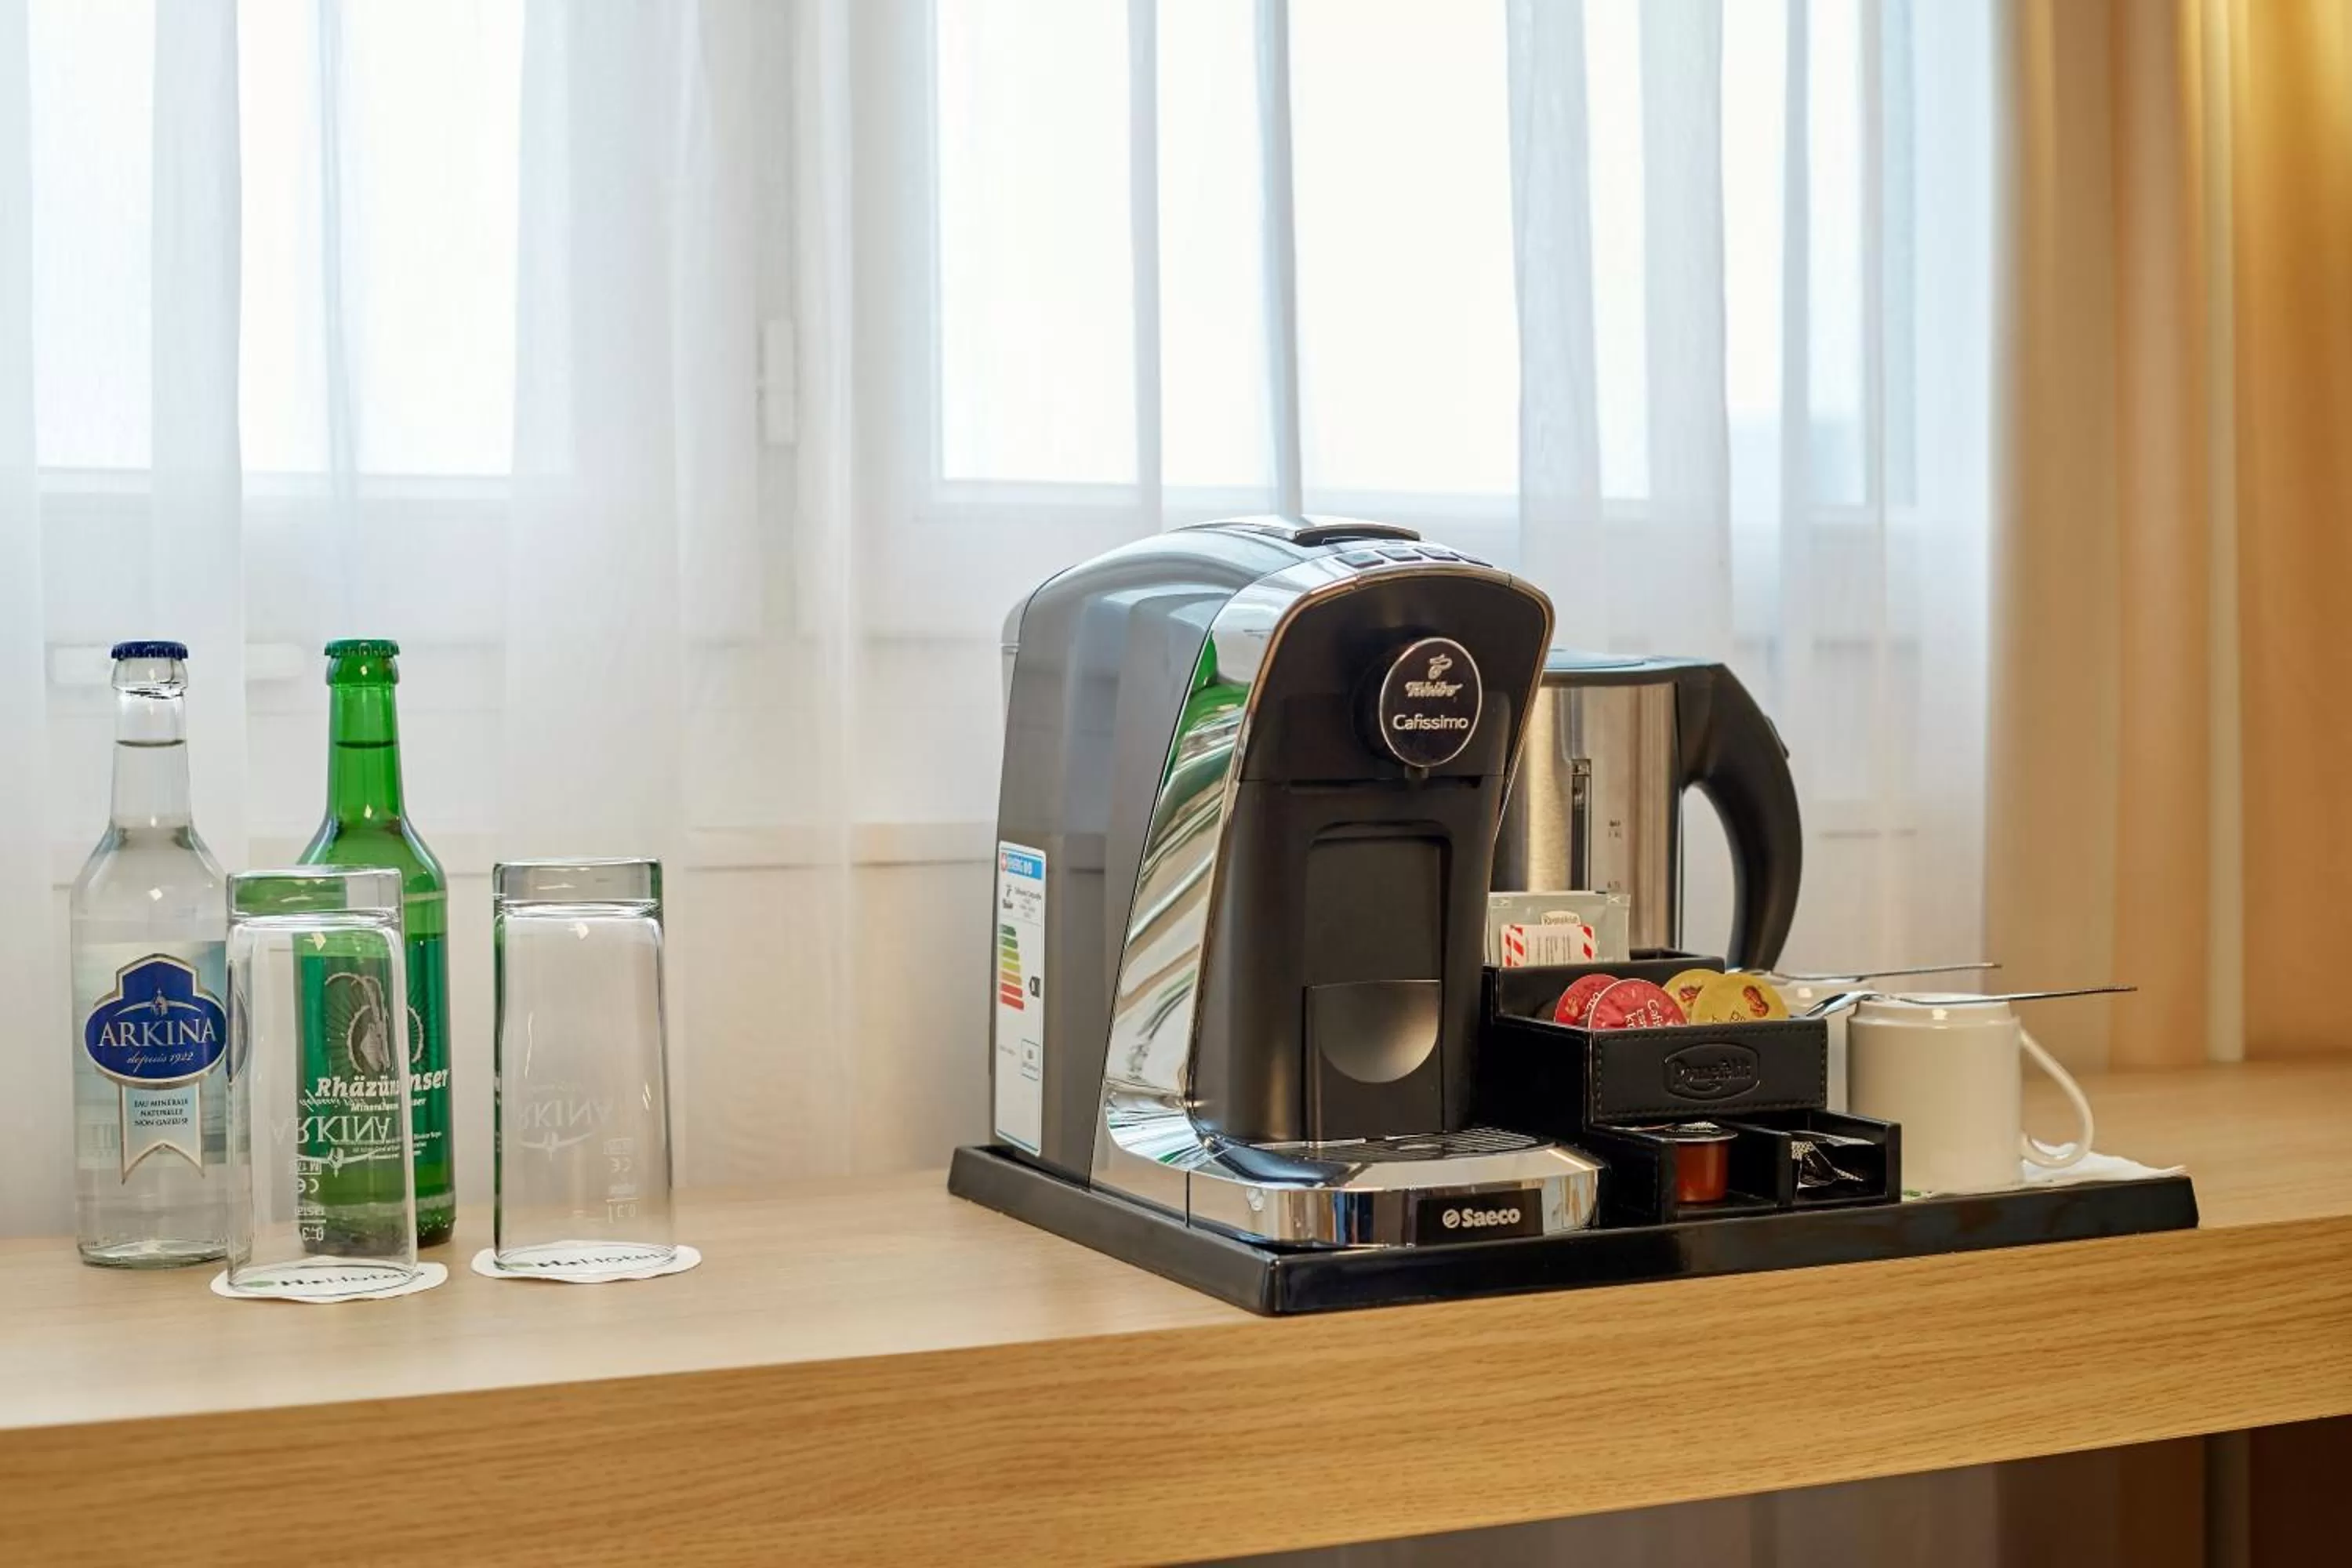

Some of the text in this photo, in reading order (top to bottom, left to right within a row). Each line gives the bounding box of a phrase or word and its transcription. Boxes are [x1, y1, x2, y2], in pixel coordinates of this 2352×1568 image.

[1392, 713, 1468, 731] Cafissimo
[97, 1018, 217, 1047] ARKINA
[126, 1051, 167, 1074] depuis
[133, 1099, 149, 1108] EAU
[133, 1118, 154, 1127] NON
[1461, 1207, 1521, 1229] Saeco
